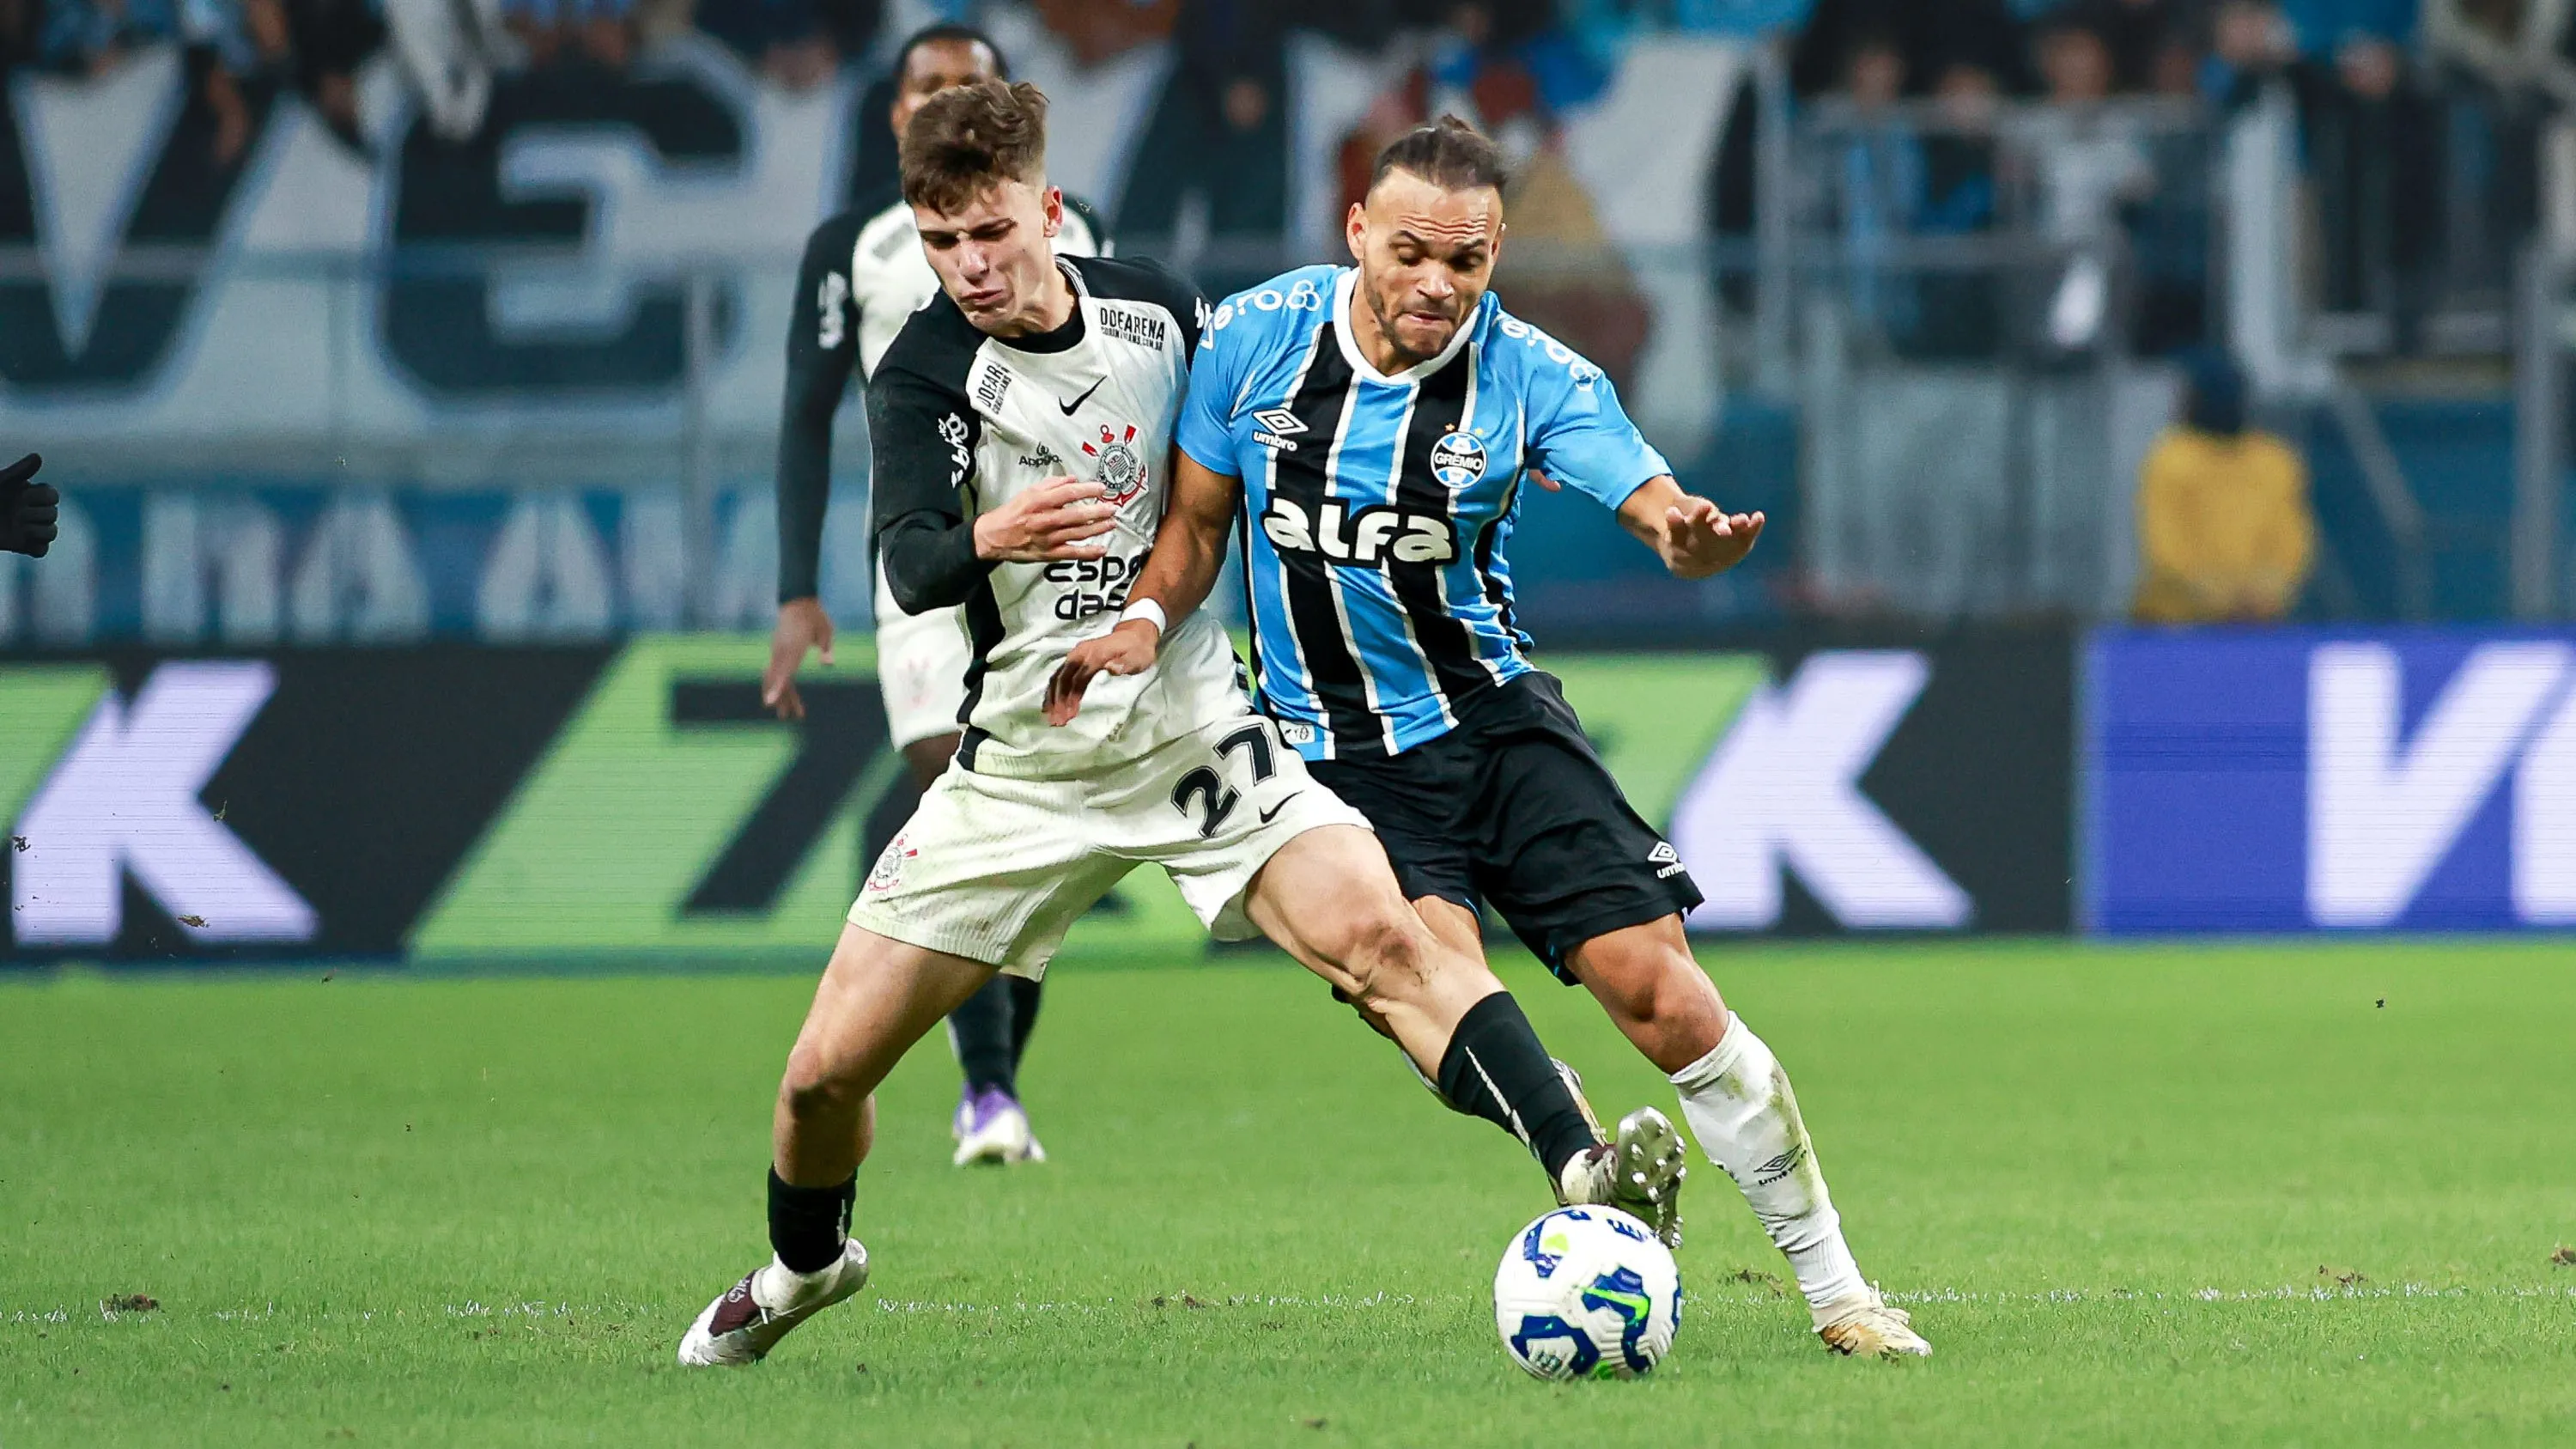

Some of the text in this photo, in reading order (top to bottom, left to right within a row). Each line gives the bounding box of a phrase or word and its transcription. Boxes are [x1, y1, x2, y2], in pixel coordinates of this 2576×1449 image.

[1253, 431, 1297, 452] umbro
[1434, 452, 1484, 471] GRÊMIO
[1263, 497, 1453, 563] alfa
[1170, 722, 1277, 838] 27
[1656, 861, 1686, 879] umb
